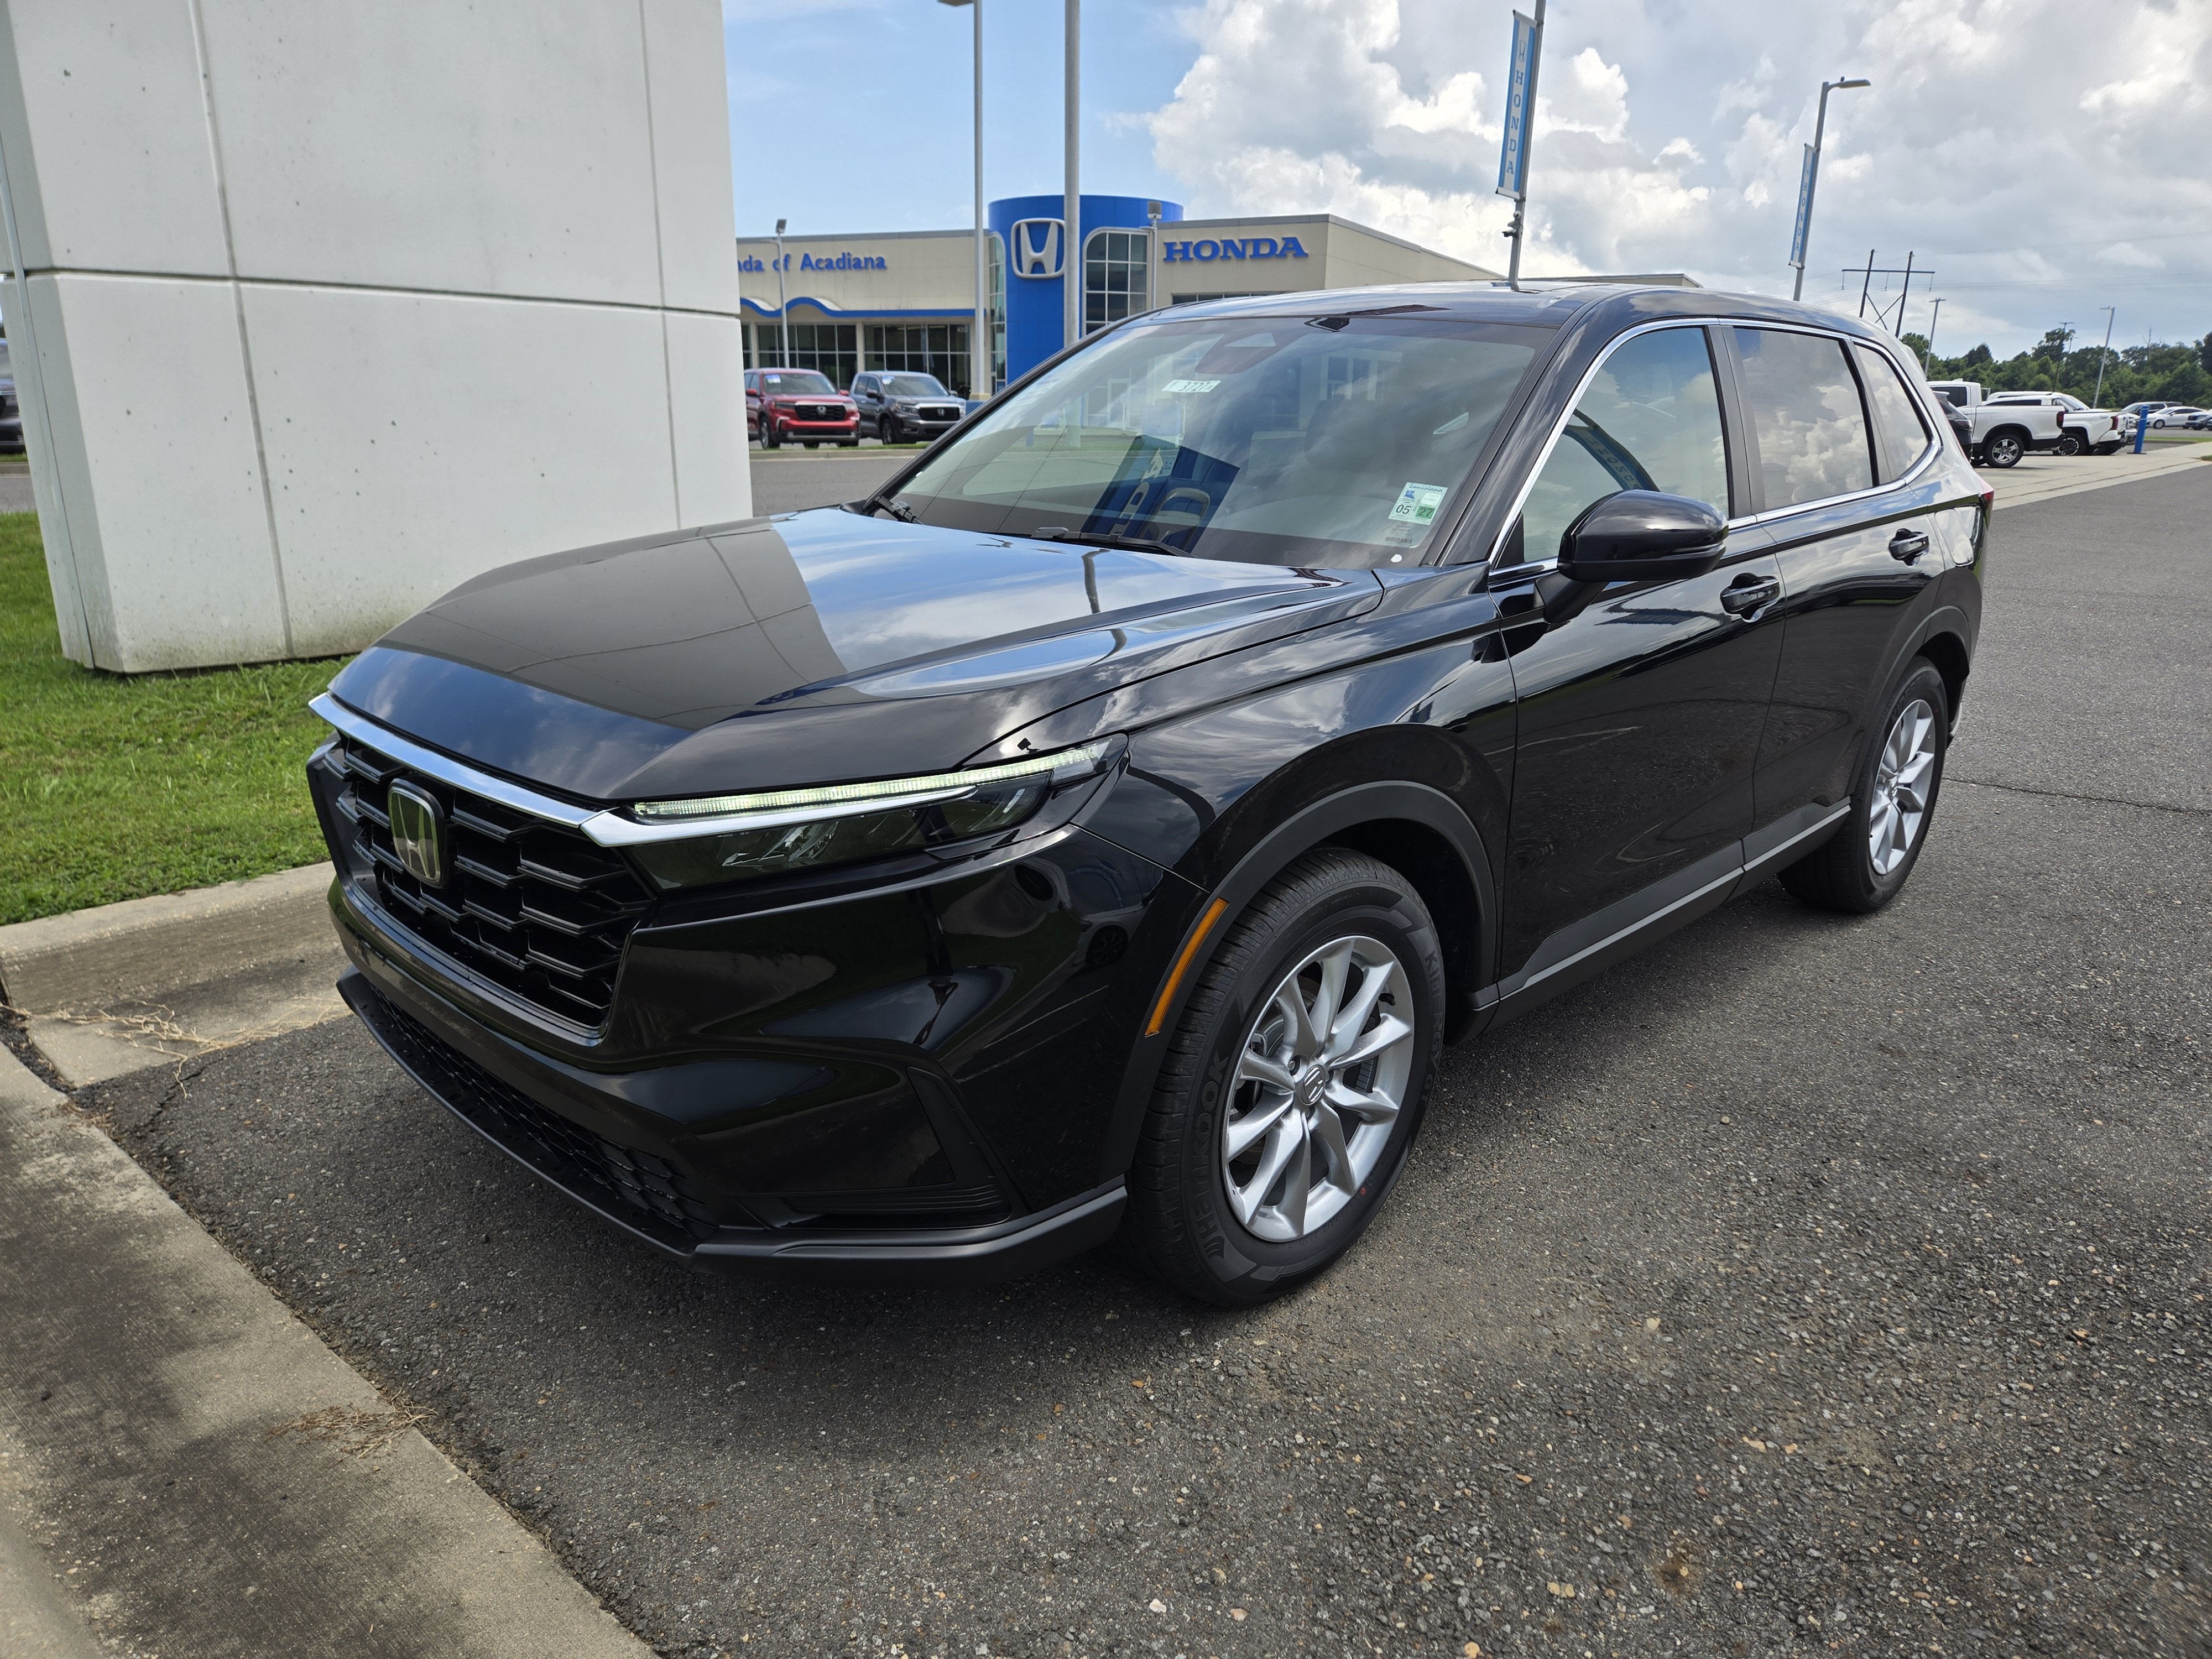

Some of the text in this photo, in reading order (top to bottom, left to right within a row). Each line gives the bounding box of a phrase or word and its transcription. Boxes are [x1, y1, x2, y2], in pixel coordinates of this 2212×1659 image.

[1506, 70, 1524, 174] HONDA
[1795, 182, 1808, 251] HONDA
[1163, 237, 1309, 262] HONDA
[773, 254, 791, 272] of
[800, 252, 886, 270] Acadiana
[1409, 483, 1443, 492] Louisiana
[1396, 504, 1412, 514] 05
[1417, 507, 1435, 517] 27
